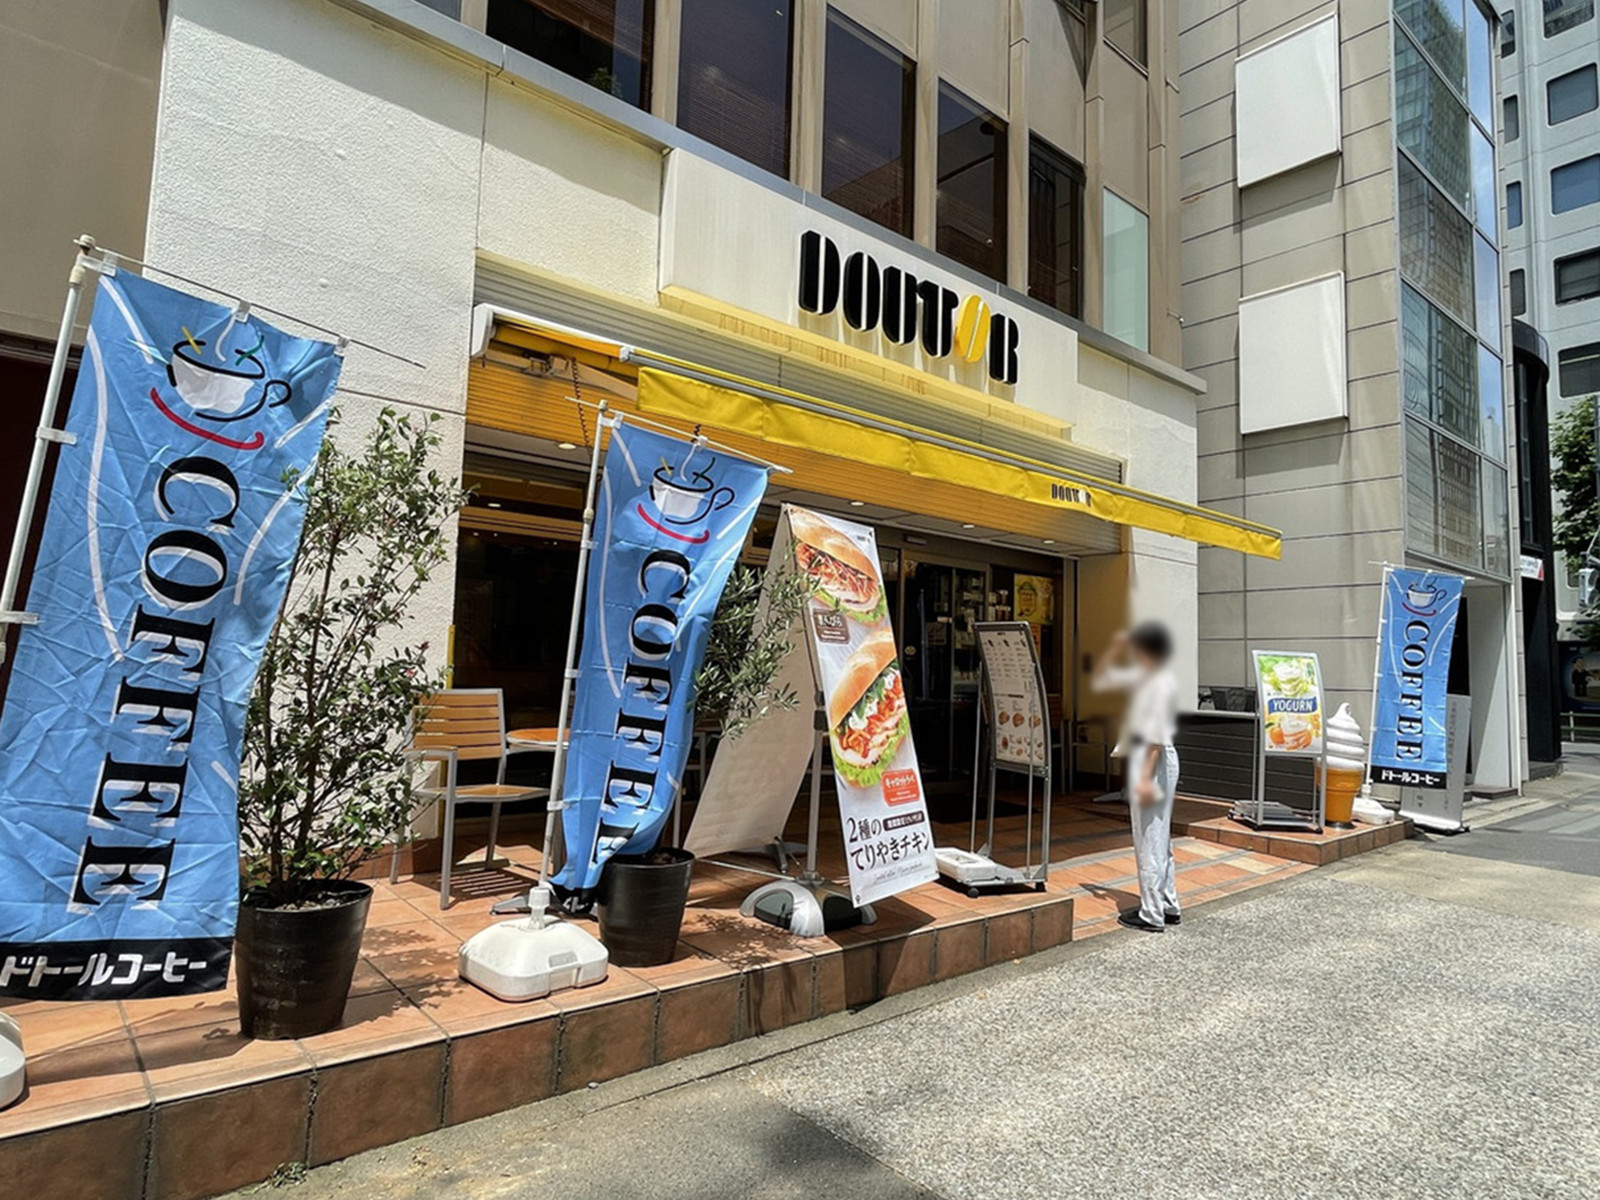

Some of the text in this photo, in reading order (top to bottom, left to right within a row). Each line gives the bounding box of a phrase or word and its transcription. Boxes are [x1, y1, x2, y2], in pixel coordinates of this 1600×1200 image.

[798, 230, 1019, 385] DOUTOR
[67, 456, 240, 913] COFFEE
[1395, 620, 1431, 761] COFFEE
[1273, 699, 1313, 711] YOGURN
[1381, 771, 1440, 784] ドトールコーヒー
[850, 832, 931, 870] てりやきチキン
[0, 952, 207, 987] ドトールコーヒー
